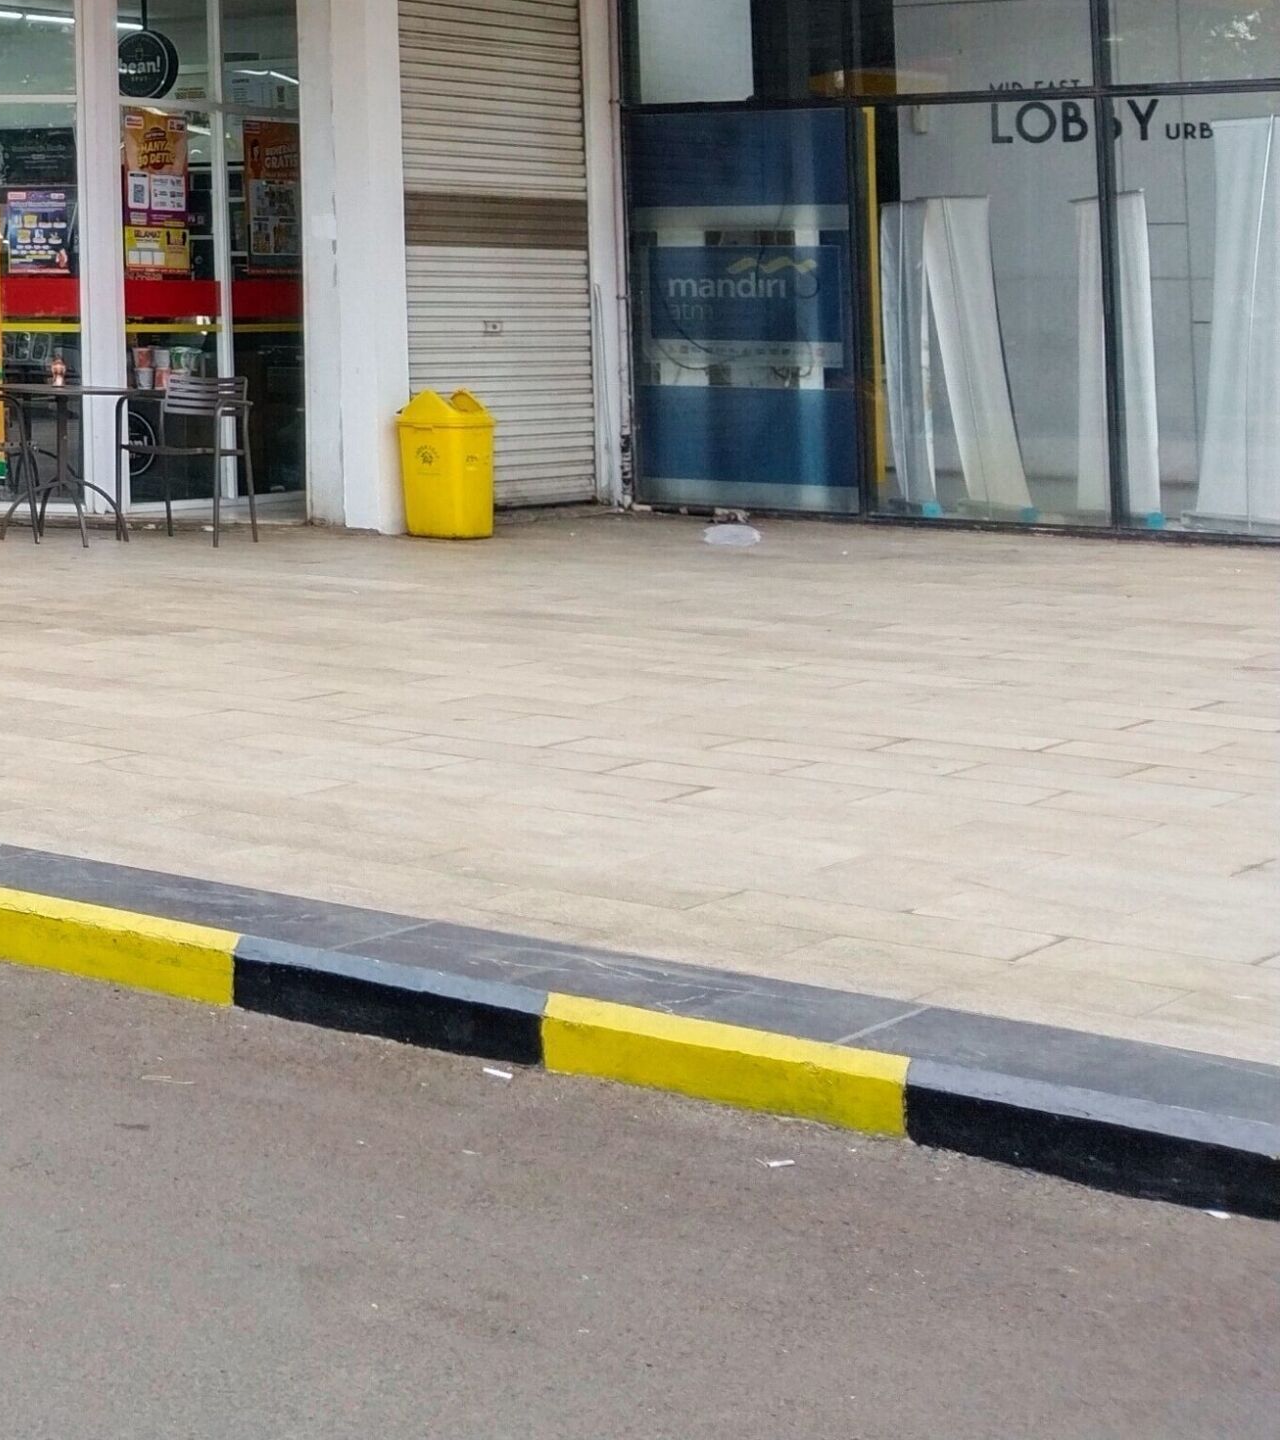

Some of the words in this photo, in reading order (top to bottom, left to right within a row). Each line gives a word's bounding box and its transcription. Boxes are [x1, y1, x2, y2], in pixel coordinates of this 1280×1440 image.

[119, 56, 161, 74] bean!
[991, 98, 1160, 144] LOBY
[1164, 122, 1215, 141] URB
[668, 271, 786, 299] mandiri
